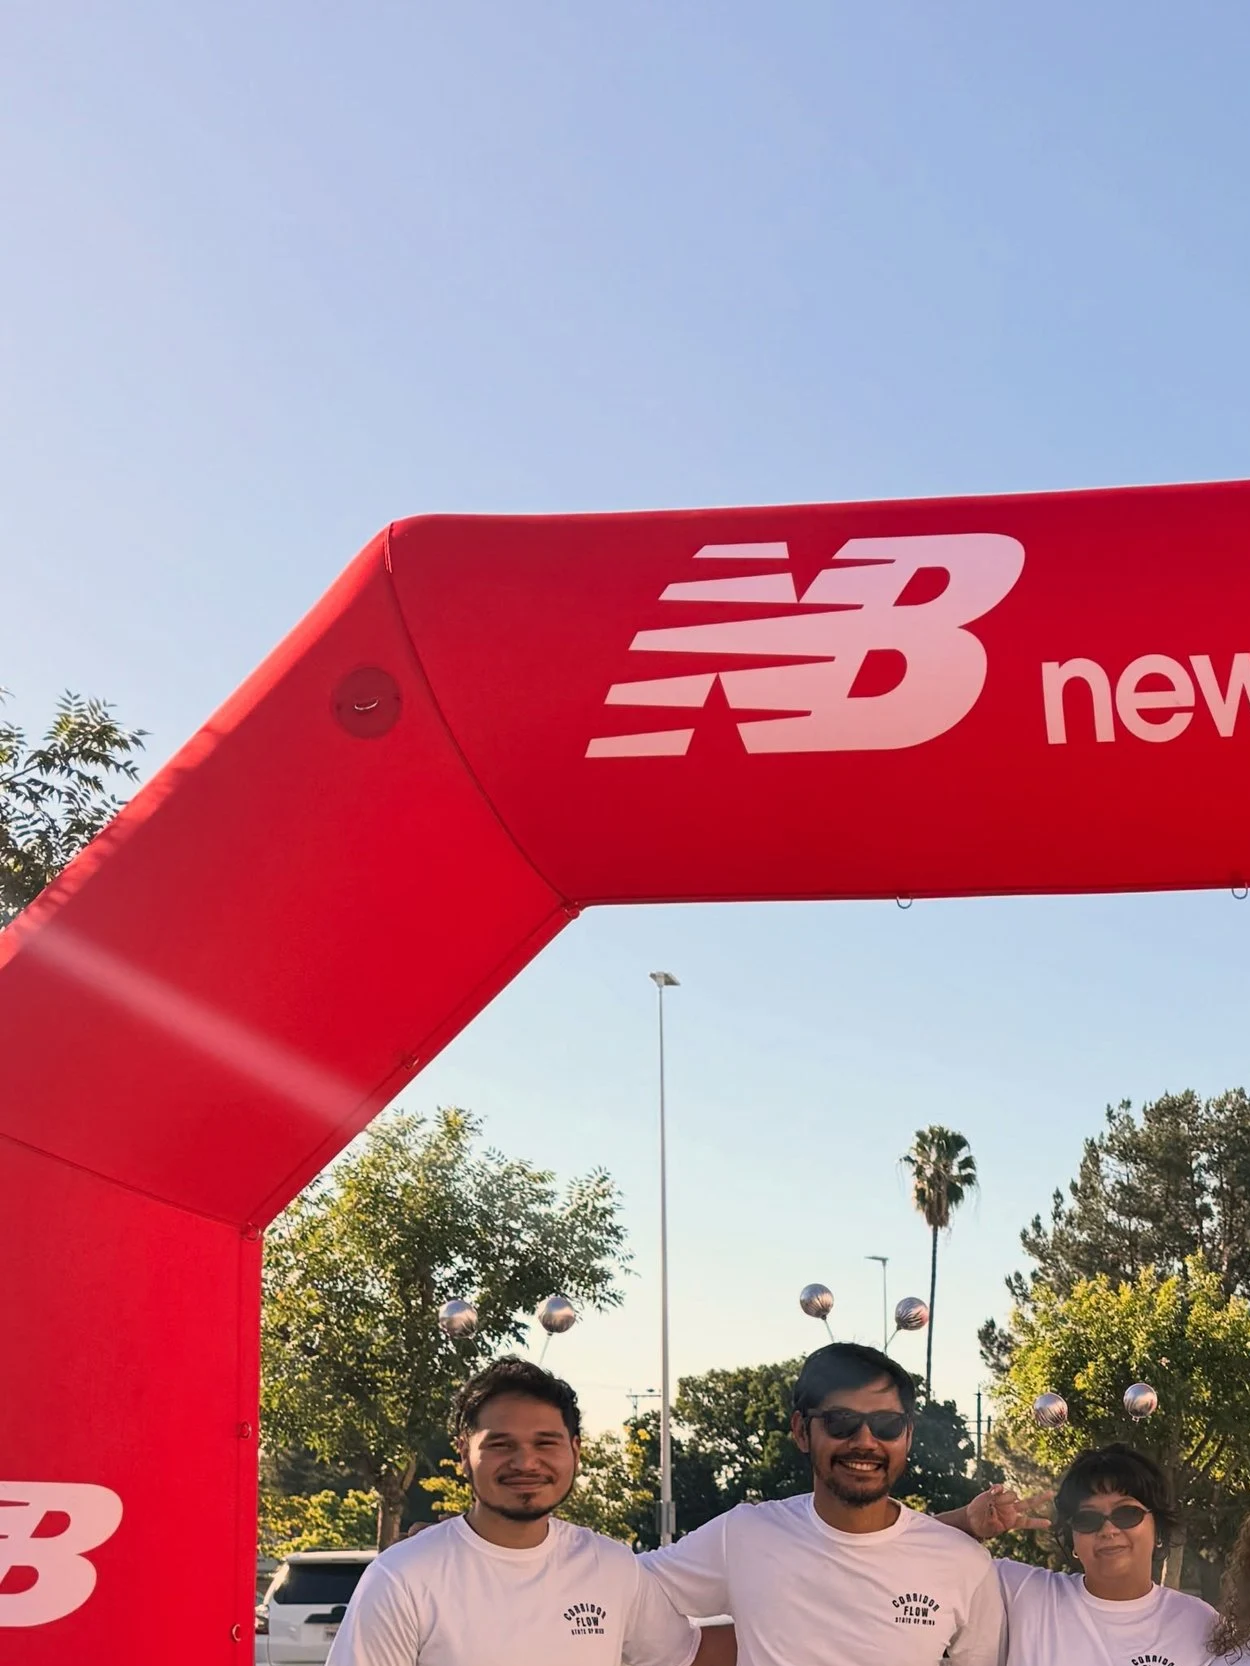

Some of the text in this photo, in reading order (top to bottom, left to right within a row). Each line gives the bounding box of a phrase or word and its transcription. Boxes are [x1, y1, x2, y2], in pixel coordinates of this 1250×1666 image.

[585, 532, 1026, 758] NB
[0, 1481, 124, 1627] B
[892, 1593, 940, 1612] CORRIDOR
[904, 1606, 928, 1617] FLOW
[564, 1603, 606, 1621] CORRIDOR
[576, 1616, 598, 1627] FLOW
